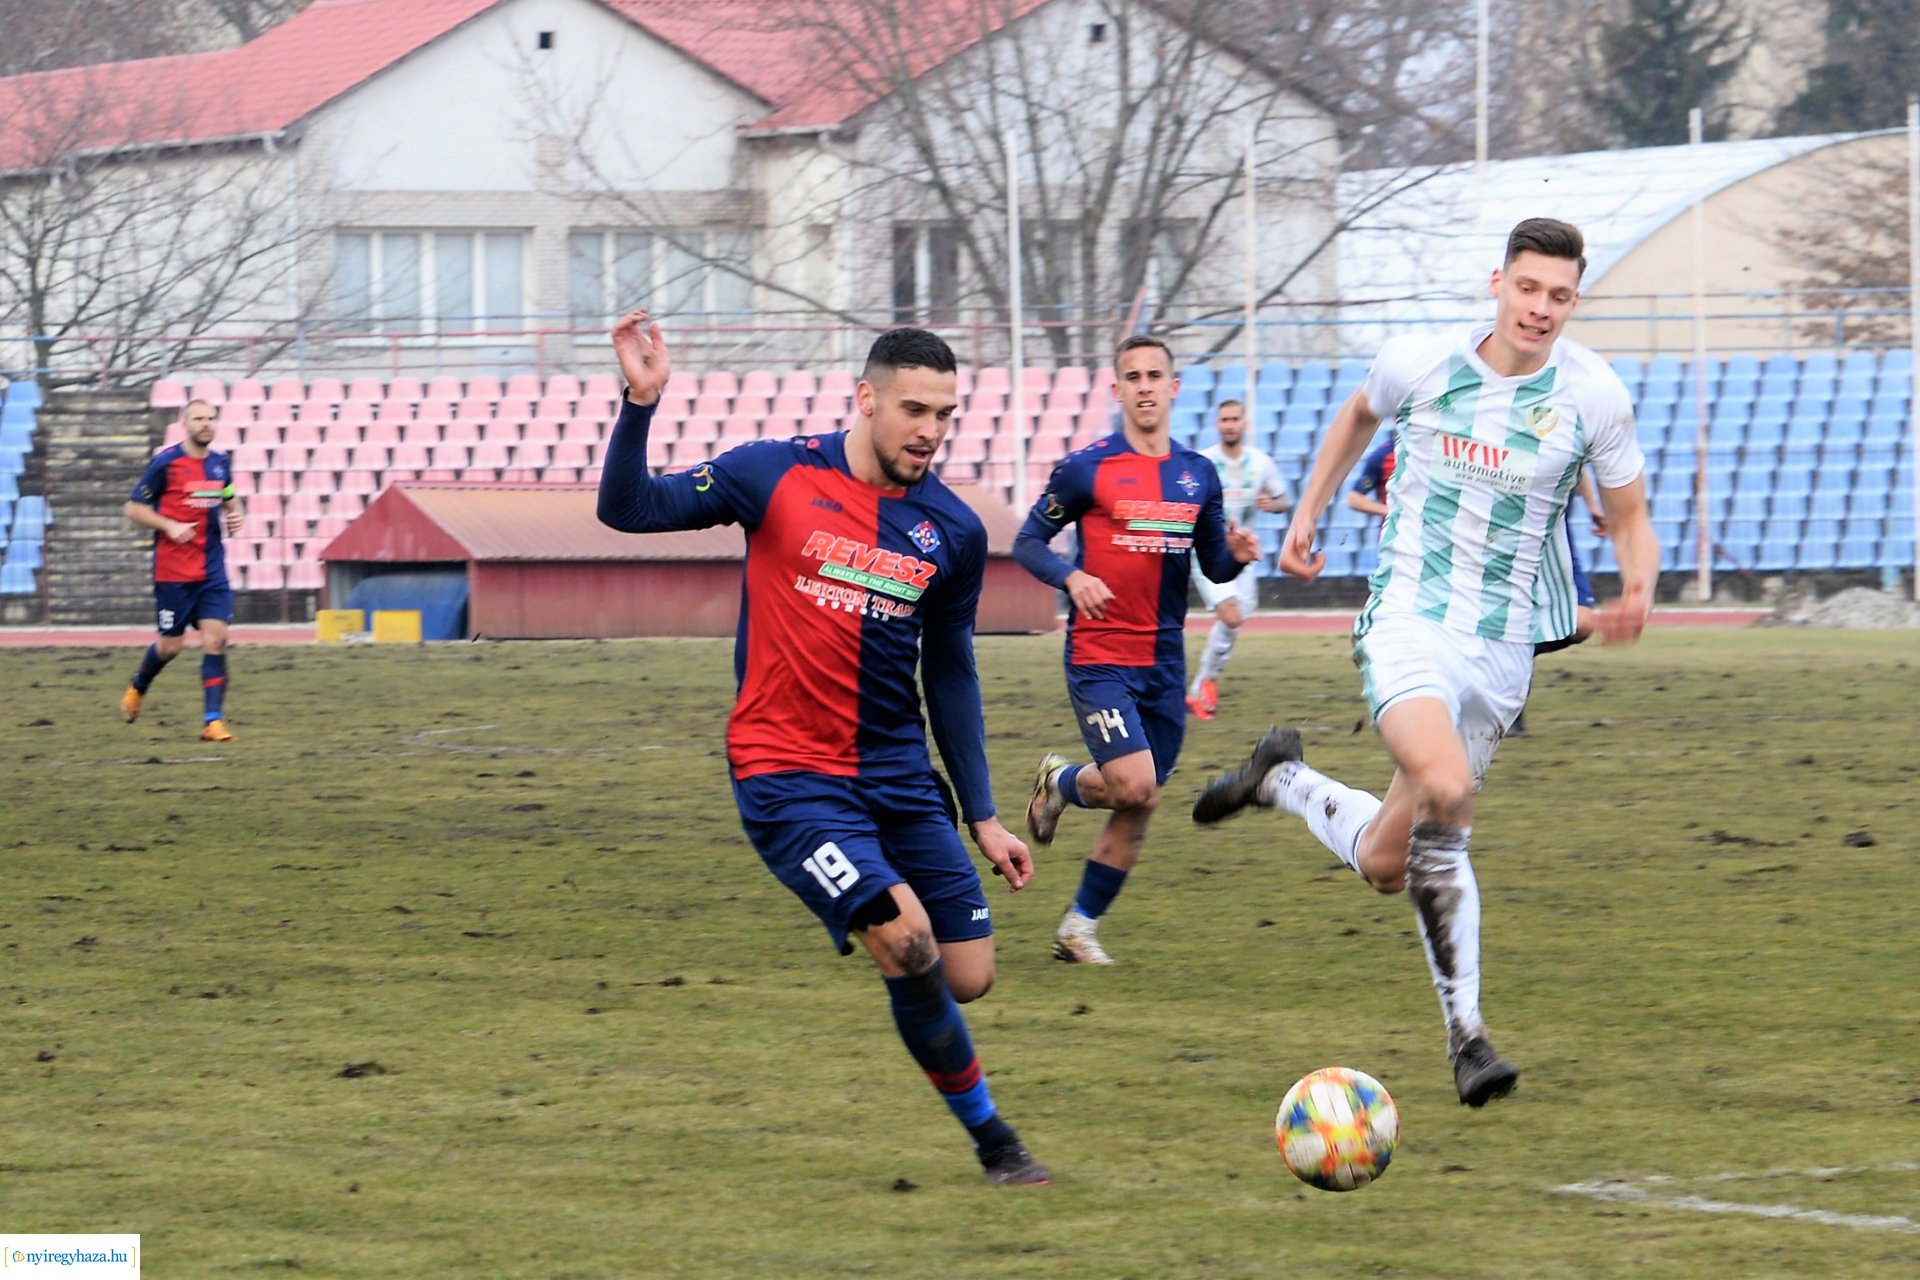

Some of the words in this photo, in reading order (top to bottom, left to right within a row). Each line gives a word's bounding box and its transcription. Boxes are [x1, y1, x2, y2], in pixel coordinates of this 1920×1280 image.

[1444, 458, 1526, 485] automotive
[821, 565, 855, 579] ALWAYS
[856, 572, 868, 582] ON
[869, 576, 884, 587] THE
[882, 580, 906, 595] RIGHT
[1086, 708, 1129, 743] 74
[802, 841, 860, 898] 19
